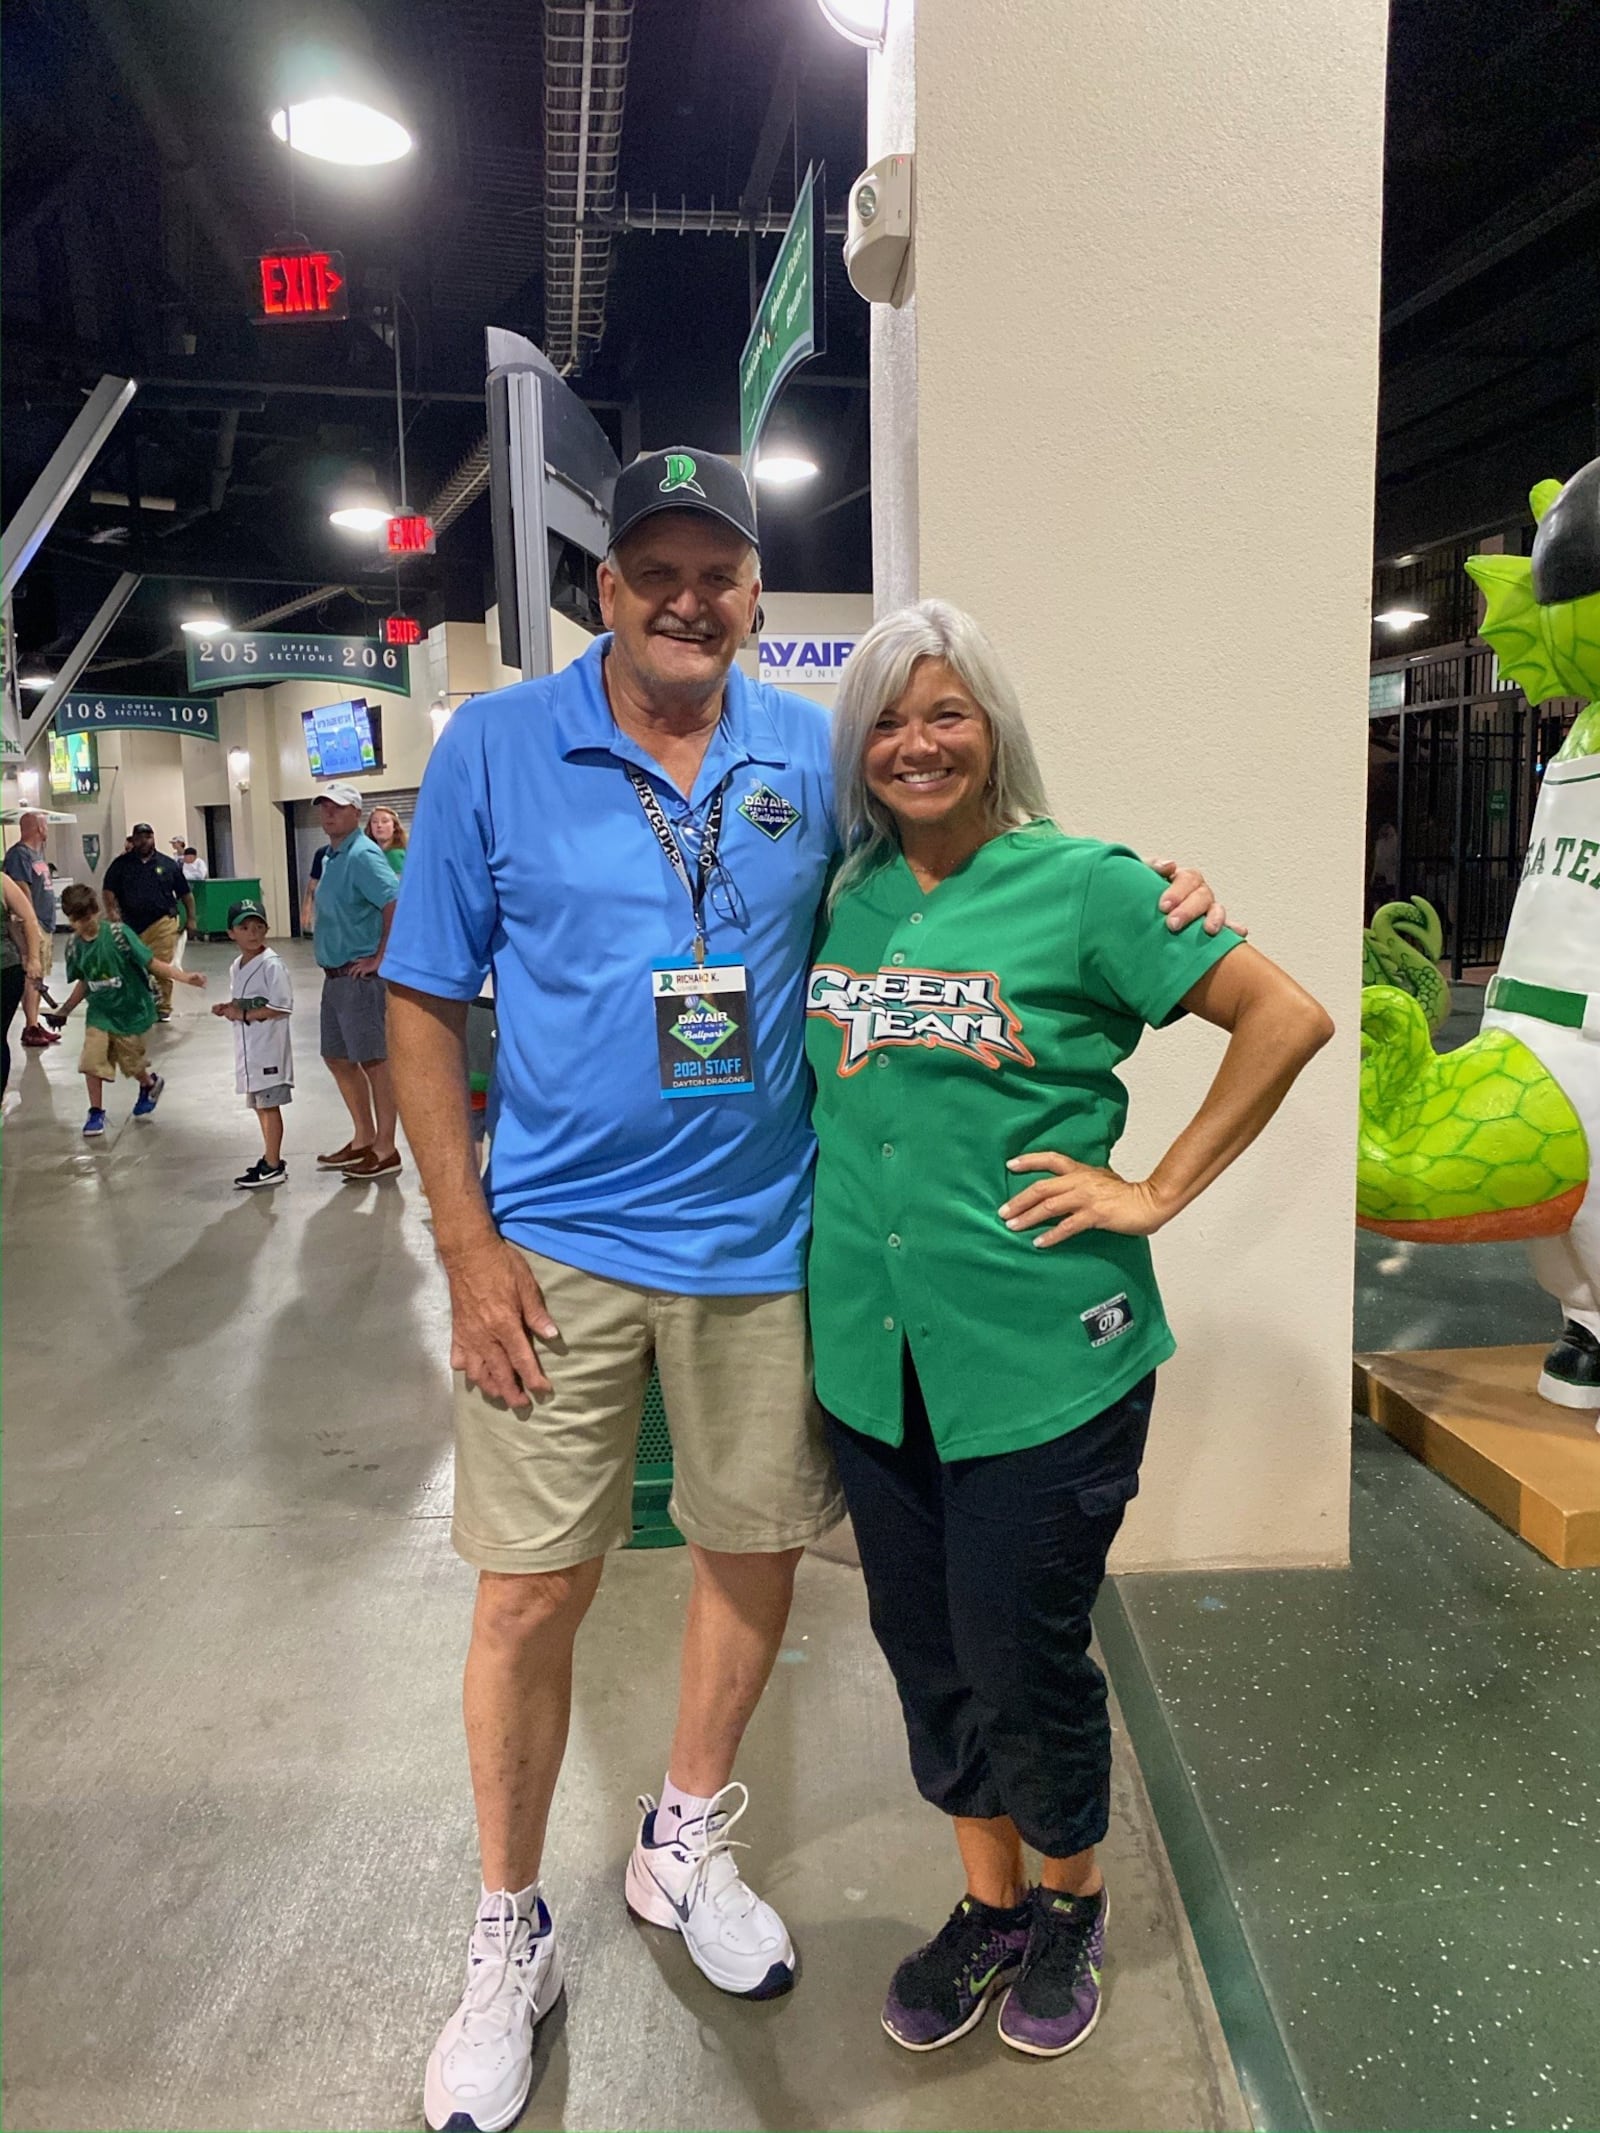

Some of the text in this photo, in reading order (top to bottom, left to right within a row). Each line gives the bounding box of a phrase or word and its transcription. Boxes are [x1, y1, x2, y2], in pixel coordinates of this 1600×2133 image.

[261, 254, 329, 313] EXIT
[388, 516, 427, 551] EXIT
[387, 618, 417, 644] EXIT
[200, 641, 258, 664] 205
[268, 652, 333, 663] SECTIONS
[281, 644, 320, 652] UPPER
[342, 647, 398, 669] 206
[65, 702, 107, 719] 108
[114, 709, 163, 718] SECTIONS
[121, 703, 155, 711] LOWER
[169, 706, 209, 725] 109
[806, 967, 1000, 1012] GREEN
[683, 1030, 724, 1041] Ballpark
[828, 1006, 1019, 1063] TEAM
[673, 1058, 742, 1078] 2021 STAFF
[672, 1076, 746, 1089] DAYTON DRAGONS
